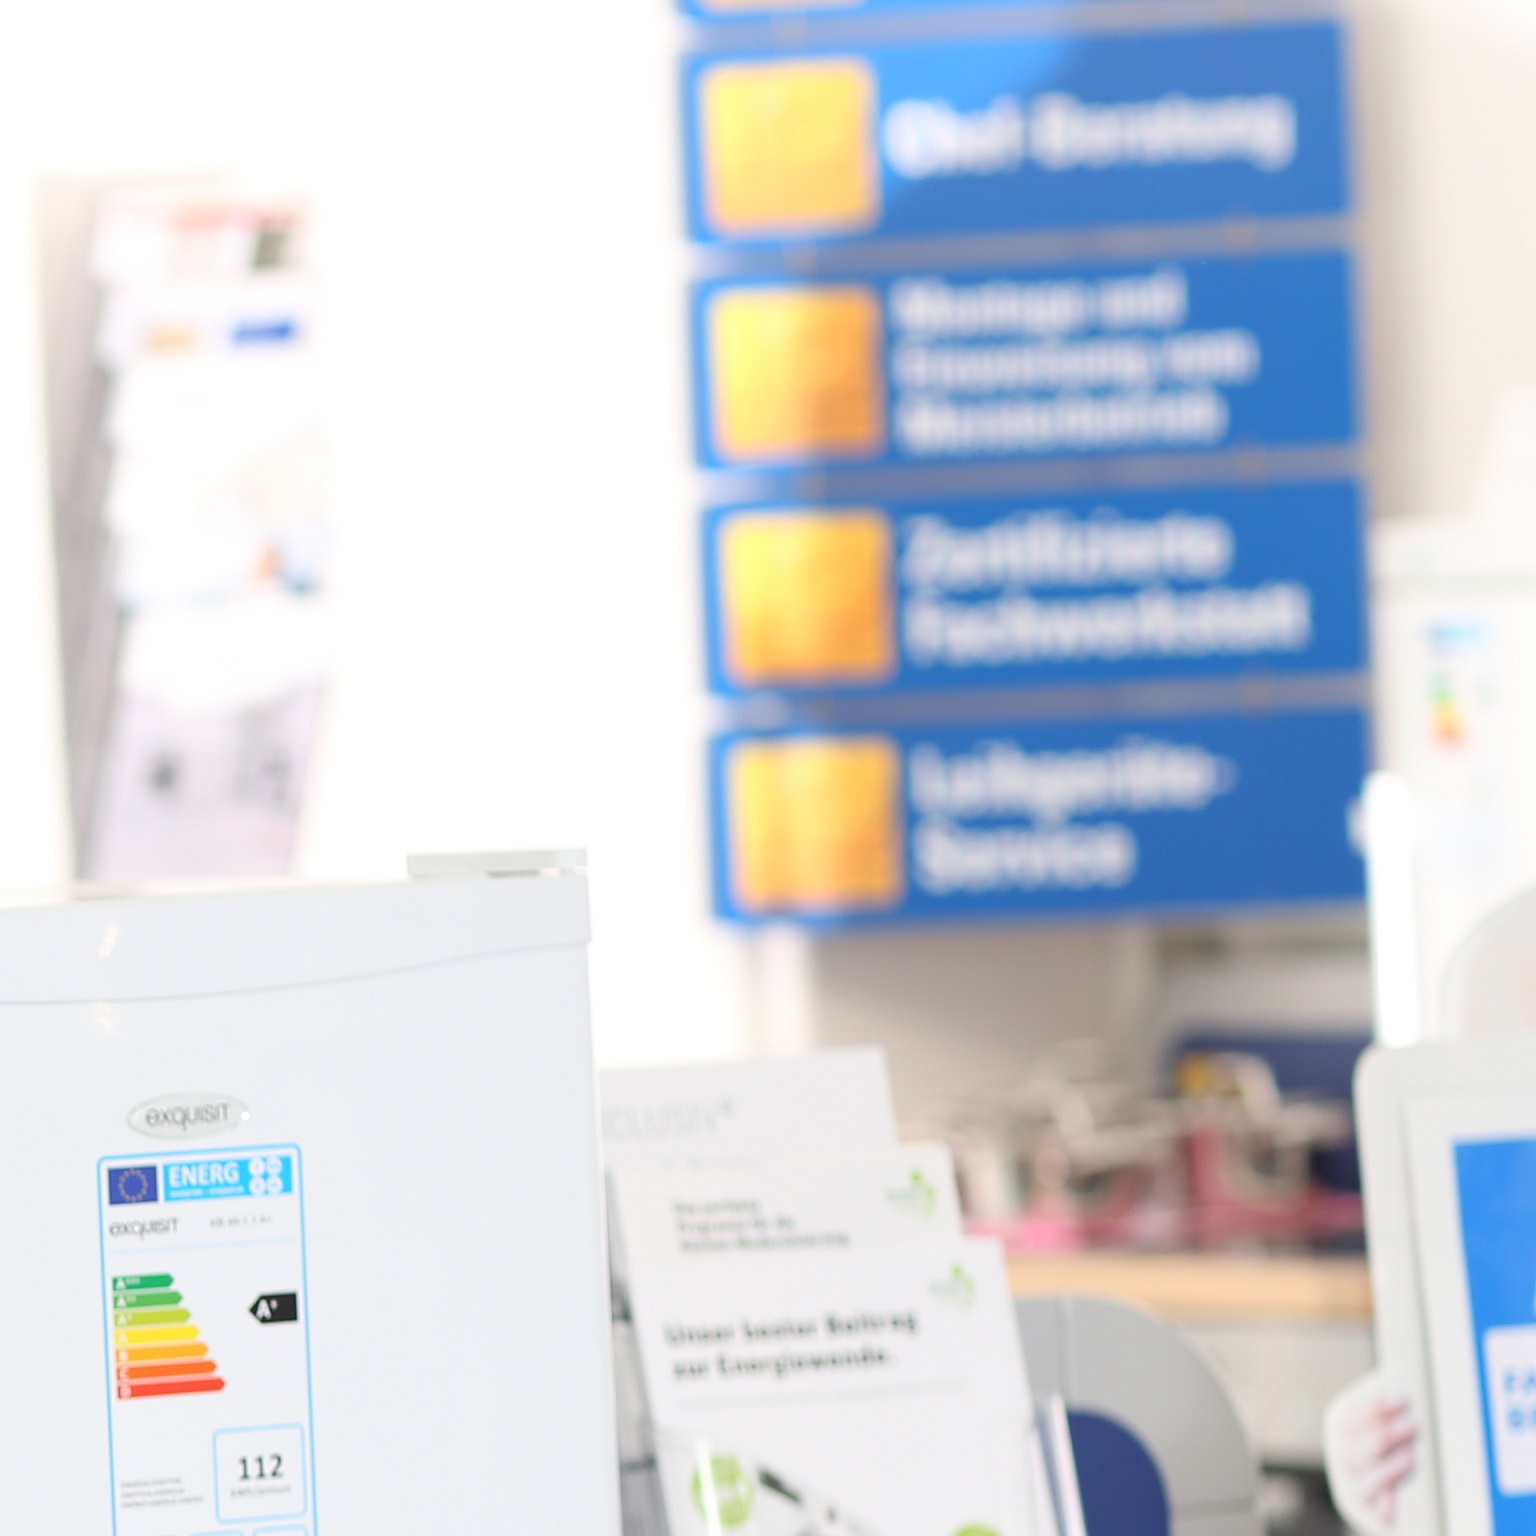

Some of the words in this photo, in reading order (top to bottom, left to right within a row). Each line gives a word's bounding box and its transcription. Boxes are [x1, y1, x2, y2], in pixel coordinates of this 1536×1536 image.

[906, 580, 1310, 667] Fachwerkstatt
[916, 823, 1137, 894] Service
[168, 1161, 240, 1188] ENERG
[663, 1319, 735, 1348] Unser
[739, 1315, 817, 1344] bester
[824, 1307, 918, 1338] Beitrag
[673, 1359, 709, 1382] zur
[237, 1453, 284, 1482] 112
